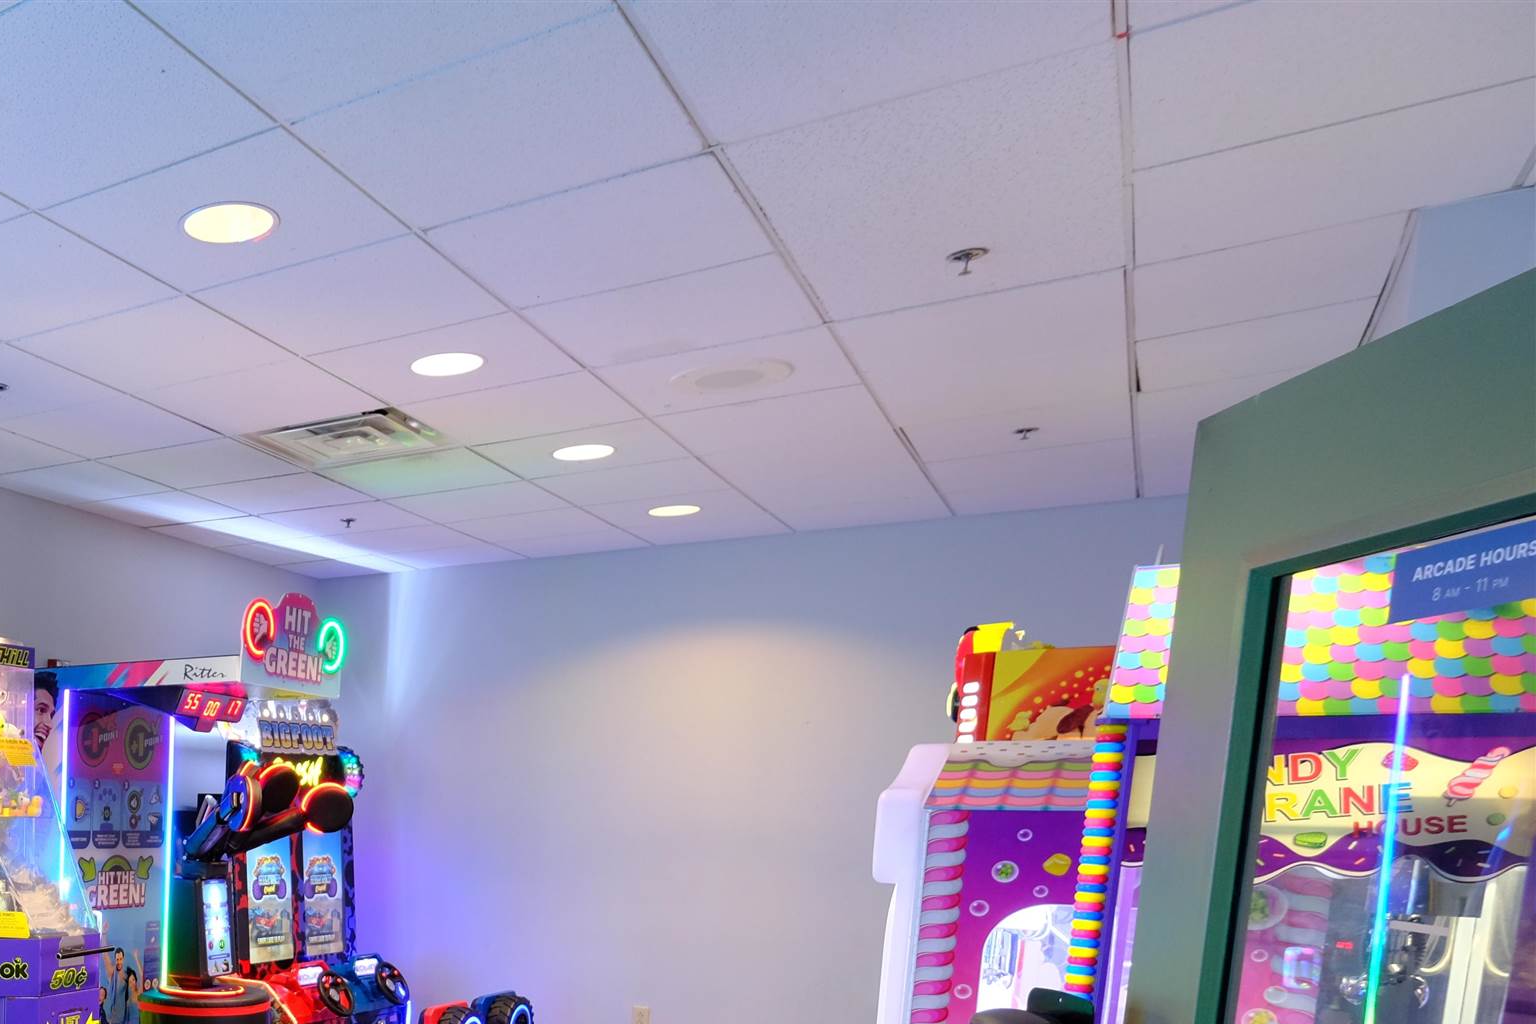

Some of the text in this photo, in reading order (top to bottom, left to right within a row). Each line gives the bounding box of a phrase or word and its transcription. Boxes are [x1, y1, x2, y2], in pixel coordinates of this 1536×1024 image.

[1412, 540, 1536, 582] ARCADE HOURS
[1432, 587, 1441, 601] 8
[1444, 587, 1461, 597] AM
[1476, 577, 1489, 592] 11
[1492, 577, 1509, 589] PM
[285, 606, 312, 635] HIT
[288, 634, 305, 651] THE
[265, 646, 323, 682] GREEN!
[184, 693, 202, 709] 55
[227, 700, 242, 715] 17
[259, 720, 334, 750] BIGFOOT
[1267, 748, 1361, 785] NDY
[1264, 782, 1414, 822] RANE
[1352, 815, 1468, 839] HOUSE
[98, 870, 135, 885] HIT THE
[85, 883, 146, 908] GREEN!
[0, 957, 28, 979] OK
[50, 967, 88, 990] 50¢
